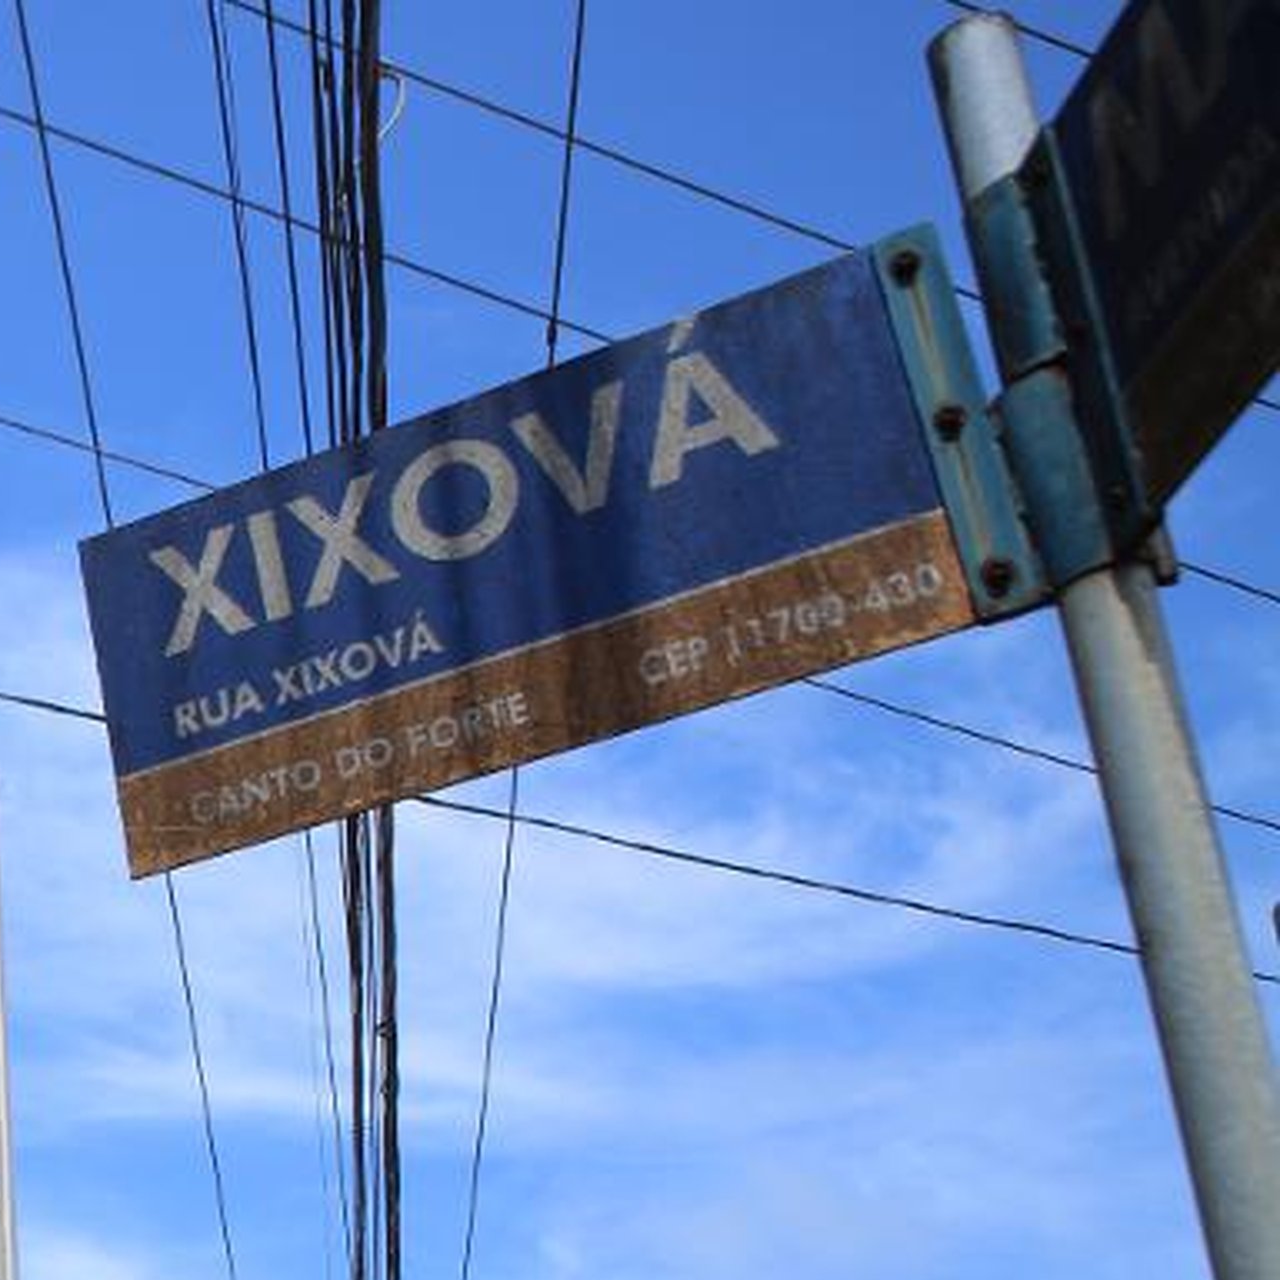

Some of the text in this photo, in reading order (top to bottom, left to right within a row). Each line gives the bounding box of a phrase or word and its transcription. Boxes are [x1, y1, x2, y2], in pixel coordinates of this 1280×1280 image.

[149, 316, 779, 658] XIXOVÁ
[174, 611, 445, 738] RUA XIXOVÁ
[640, 636, 707, 685] CEP
[191, 692, 530, 823] CANTO DO FORTE
